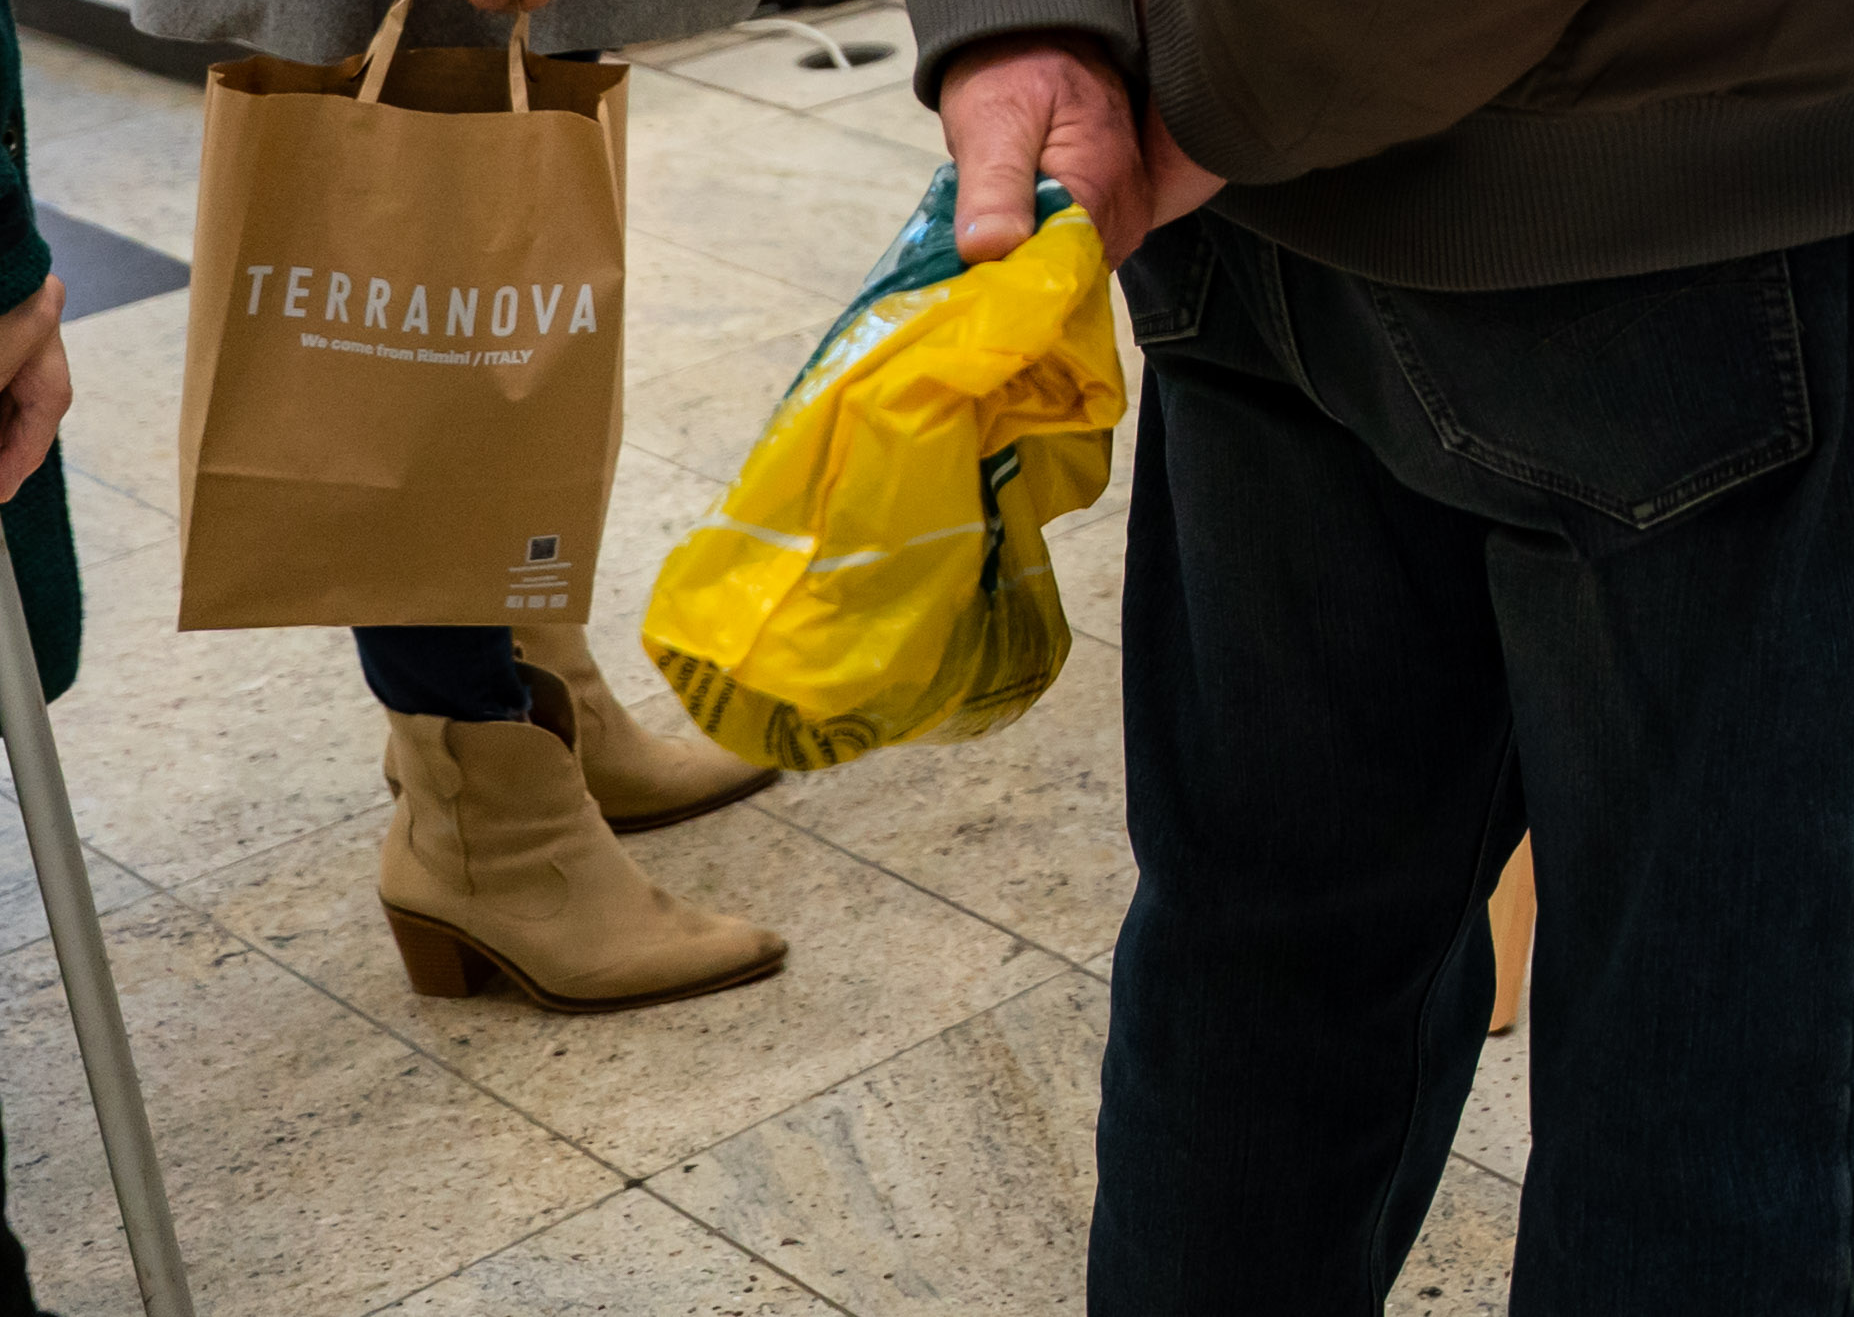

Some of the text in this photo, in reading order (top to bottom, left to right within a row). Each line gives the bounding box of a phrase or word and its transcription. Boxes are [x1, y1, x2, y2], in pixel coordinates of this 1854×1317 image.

[245, 265, 598, 339] TERRANOVA
[300, 333, 328, 349] We
[331, 338, 374, 355] come
[376, 343, 414, 362] from
[416, 348, 470, 365] Rimini
[484, 349, 534, 365] ITALY
